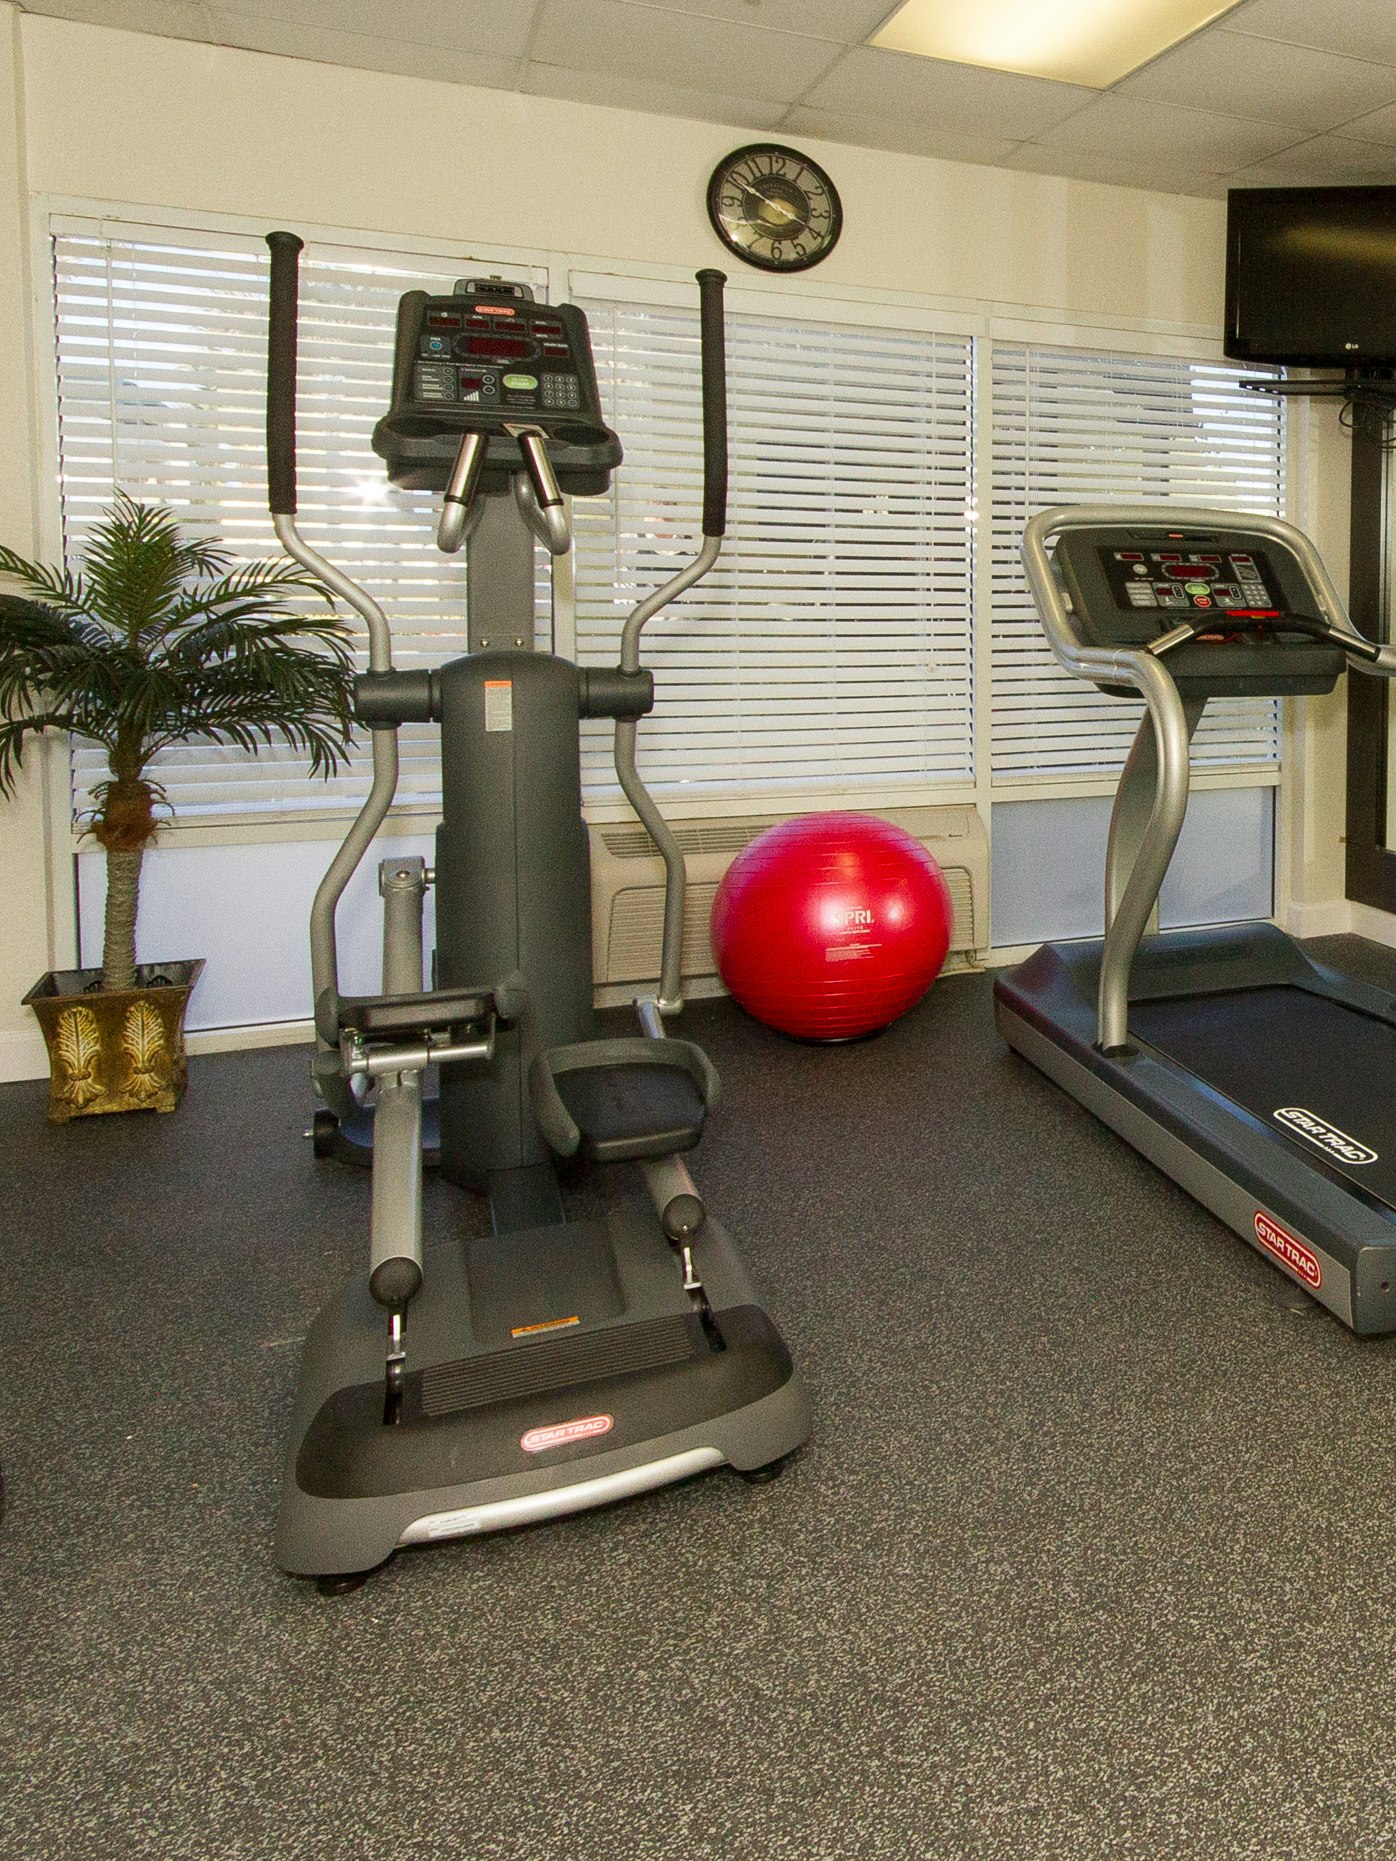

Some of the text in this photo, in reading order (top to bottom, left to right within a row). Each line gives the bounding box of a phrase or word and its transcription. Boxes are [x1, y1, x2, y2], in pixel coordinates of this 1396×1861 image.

[744, 158, 768, 180] 11
[768, 156, 787, 177] 12
[793, 166, 805, 182] 1
[727, 171, 750, 194] 10
[806, 185, 825, 201] 2
[721, 196, 744, 208] 9
[811, 208, 829, 219] 3
[806, 225, 826, 241] 4
[771, 240, 783, 259] 6
[790, 236, 807, 257] 5
[1282, 1110, 1366, 1160] STAR TRAC
[1257, 1222, 1315, 1277] STAR TRAC
[528, 1421, 603, 1442] STAR TRAC
